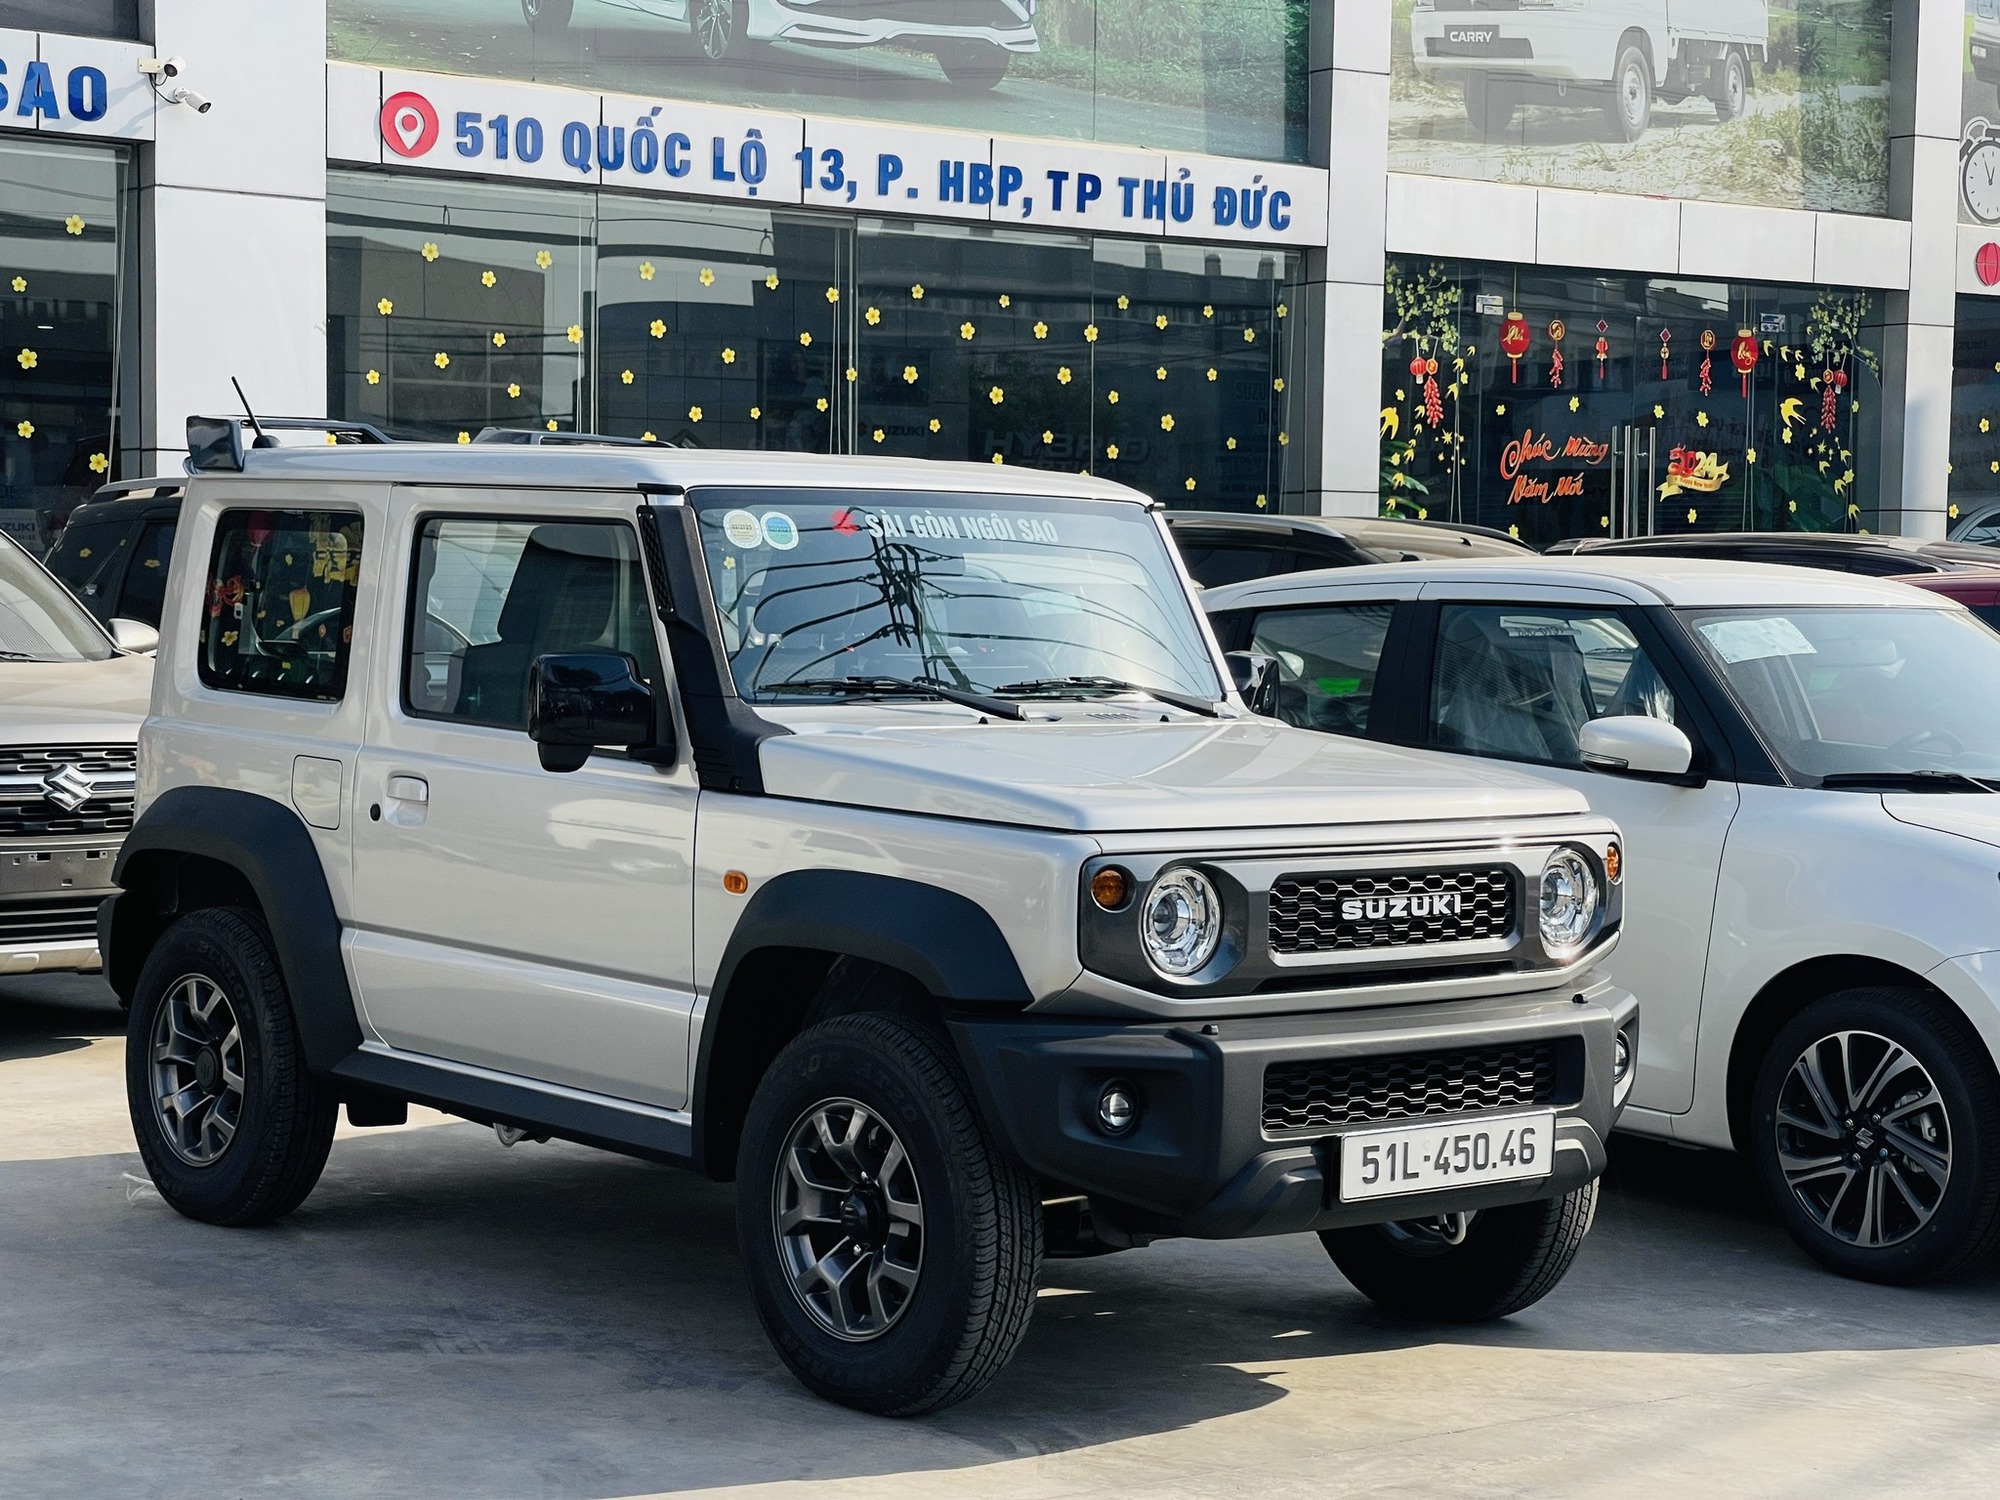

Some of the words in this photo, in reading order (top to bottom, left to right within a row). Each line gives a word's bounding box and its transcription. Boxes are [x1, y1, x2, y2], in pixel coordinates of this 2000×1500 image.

[1449, 31, 1493, 43] CARRY
[0, 59, 108, 122] AO
[456, 112, 543, 163] 510
[562, 106, 691, 178] QUỐC
[712, 128, 767, 196] LỘ
[795, 146, 857, 202] 13,
[878, 153, 918, 199] P.
[939, 159, 1033, 218] HBP,
[1047, 170, 1102, 213] TP
[1118, 167, 1194, 222] THỦ
[1212, 175, 1291, 231] ĐỨC
[1501, 428, 1561, 480] Chúc
[1562, 435, 1609, 465] Mừng
[1507, 475, 1554, 505] Năm
[864, 509, 908, 539] SÀI
[909, 510, 961, 540] GÒN
[963, 513, 1017, 542] NGÔI
[1020, 517, 1060, 544] SAO
[1342, 893, 1462, 921] SUZUKI
